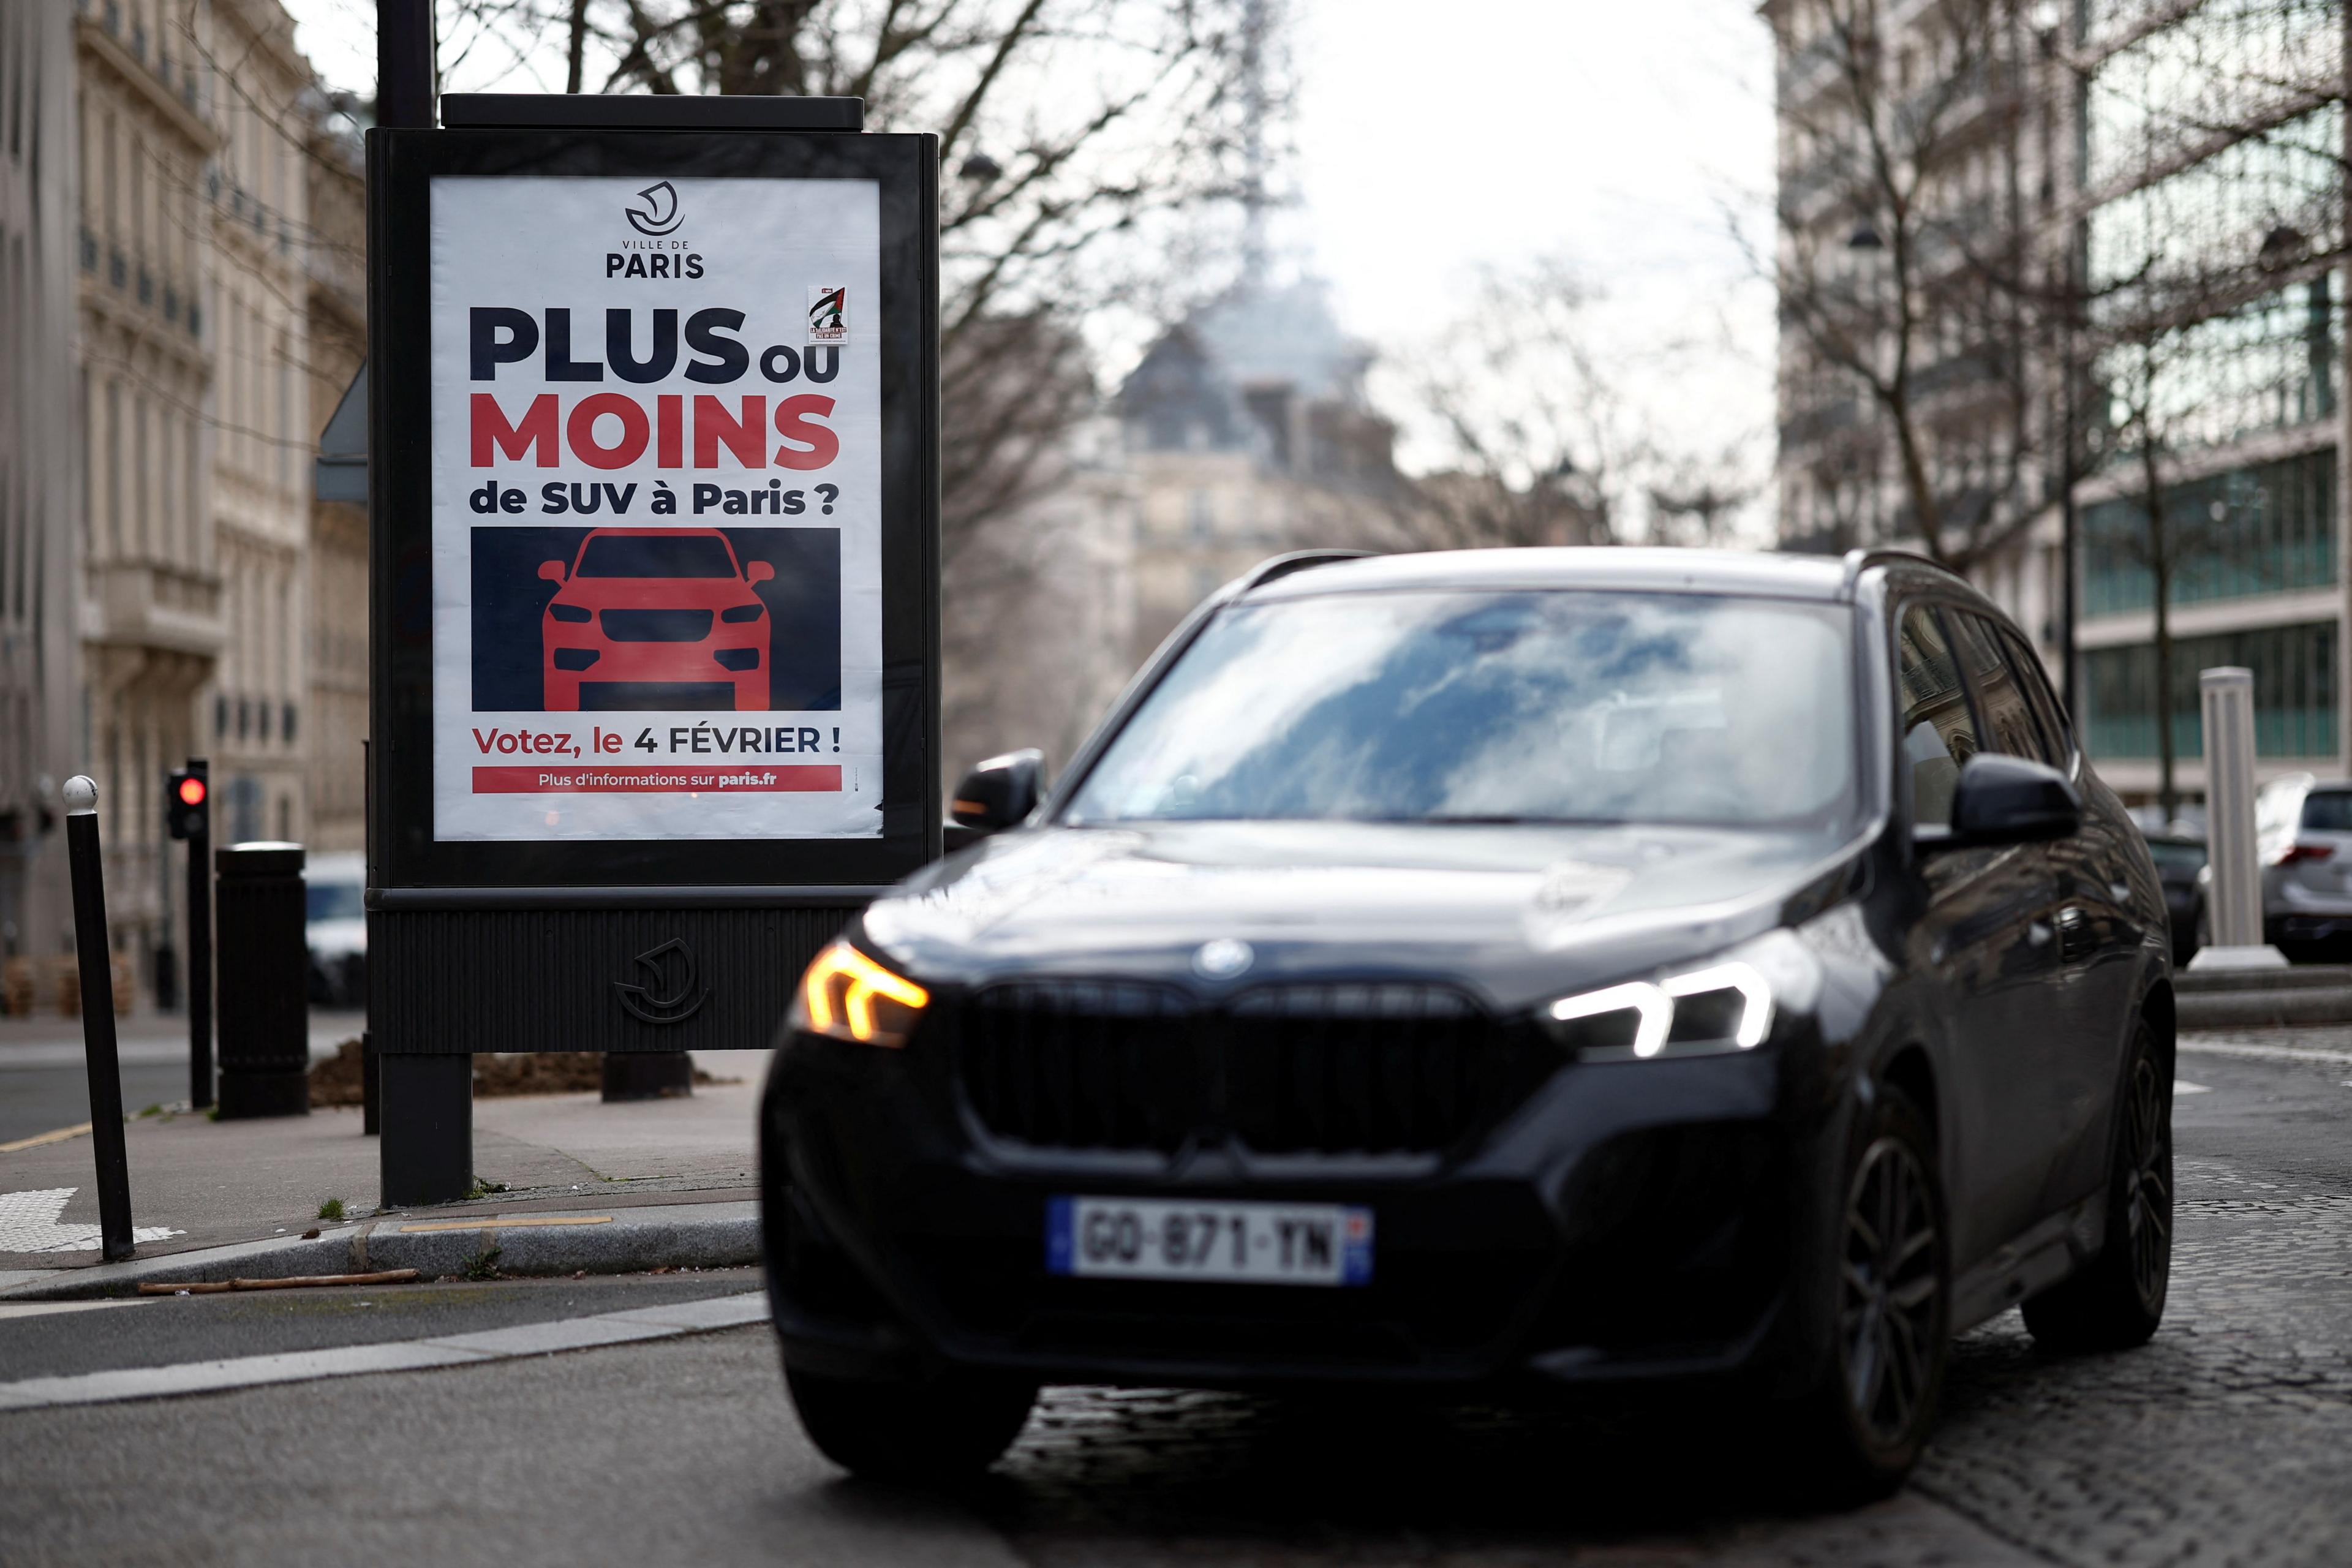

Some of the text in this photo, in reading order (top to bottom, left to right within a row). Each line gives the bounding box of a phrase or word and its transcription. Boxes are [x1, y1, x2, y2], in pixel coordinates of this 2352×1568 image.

[623, 240, 688, 250] VILLE DE
[606, 253, 704, 279] PARIS
[470, 307, 840, 384] PLUS OU
[470, 393, 840, 470] MOINS
[469, 478, 839, 515] de SUV à Paris ?
[472, 721, 840, 759] Votez, le 4 FÉVRIER !
[539, 772, 777, 788] Plus d'informations sur paris.fr
